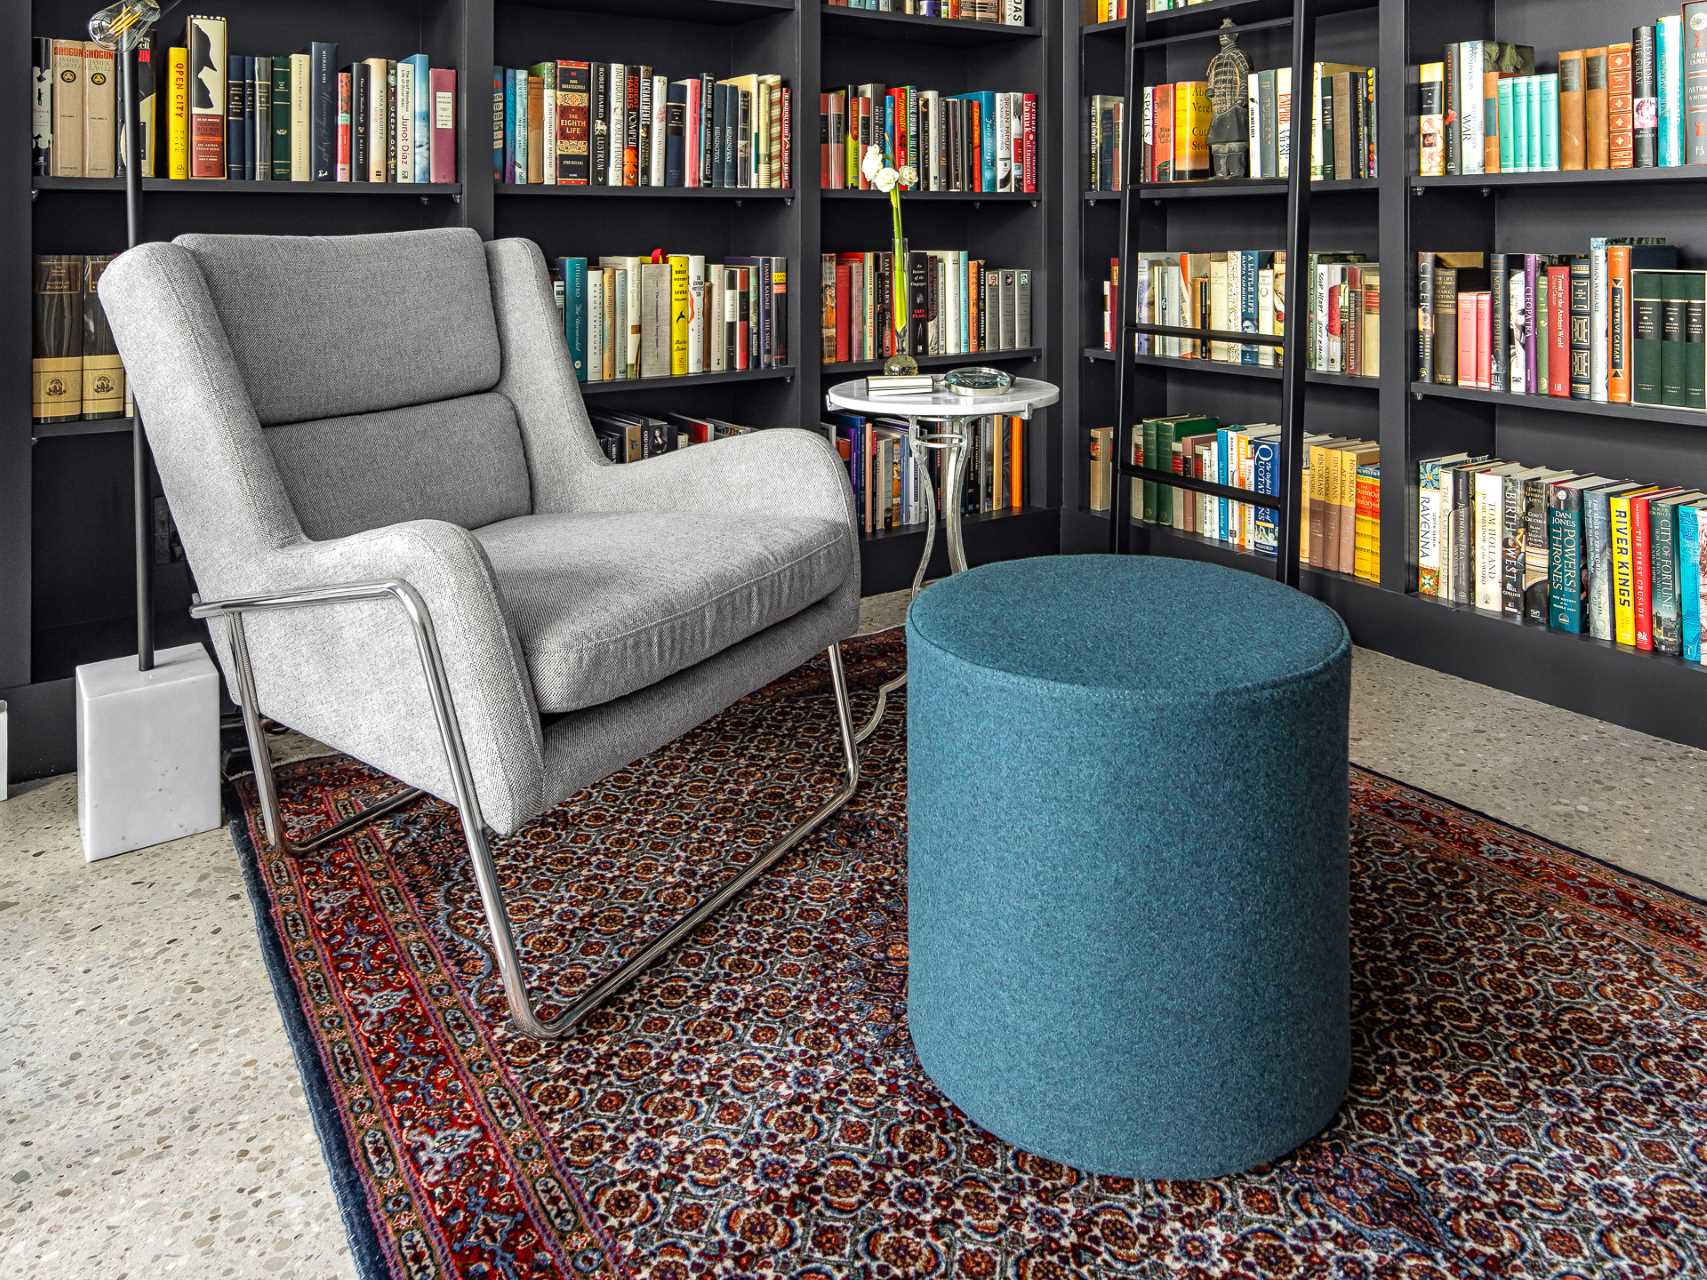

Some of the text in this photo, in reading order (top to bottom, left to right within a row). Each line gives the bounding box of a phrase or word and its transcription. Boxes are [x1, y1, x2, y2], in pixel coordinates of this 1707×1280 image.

[1634, 39, 1643, 85] THE GREAT
[1643, 35, 1652, 86] ALEXANDER
[176, 63, 184, 118] OPEN CITY
[641, 78, 651, 124] ENCHANTMENTS
[1279, 93, 1291, 125] EMPIRE
[401, 115, 409, 142] Junot
[1462, 114, 1472, 142] WAR
[401, 145, 410, 165] Díaz
[596, 136, 605, 170] LUSTRUM
[1557, 273, 1565, 292] Travel
[1524, 286, 1533, 337] CLEOPATRA
[1557, 331, 1565, 348] World
[1331, 456, 1339, 500] HISTORIANS
[1347, 458, 1355, 503] HISTORIANS
[1420, 496, 1430, 559] RAVENNA
[1488, 502, 1496, 579] TOM HOLLAND
[1505, 492, 1517, 581] BIRTH WEST
[1552, 518, 1577, 526] JONES
[1459, 543, 1467, 559] FLEA
[1552, 527, 1562, 589] THRONES
[1563, 529, 1575, 586] POWERS
[1615, 509, 1630, 607] RIVER KINGS
[1660, 519, 1672, 609] CITY OF FORTUNE
[1636, 580, 1644, 619] CRUSADE
